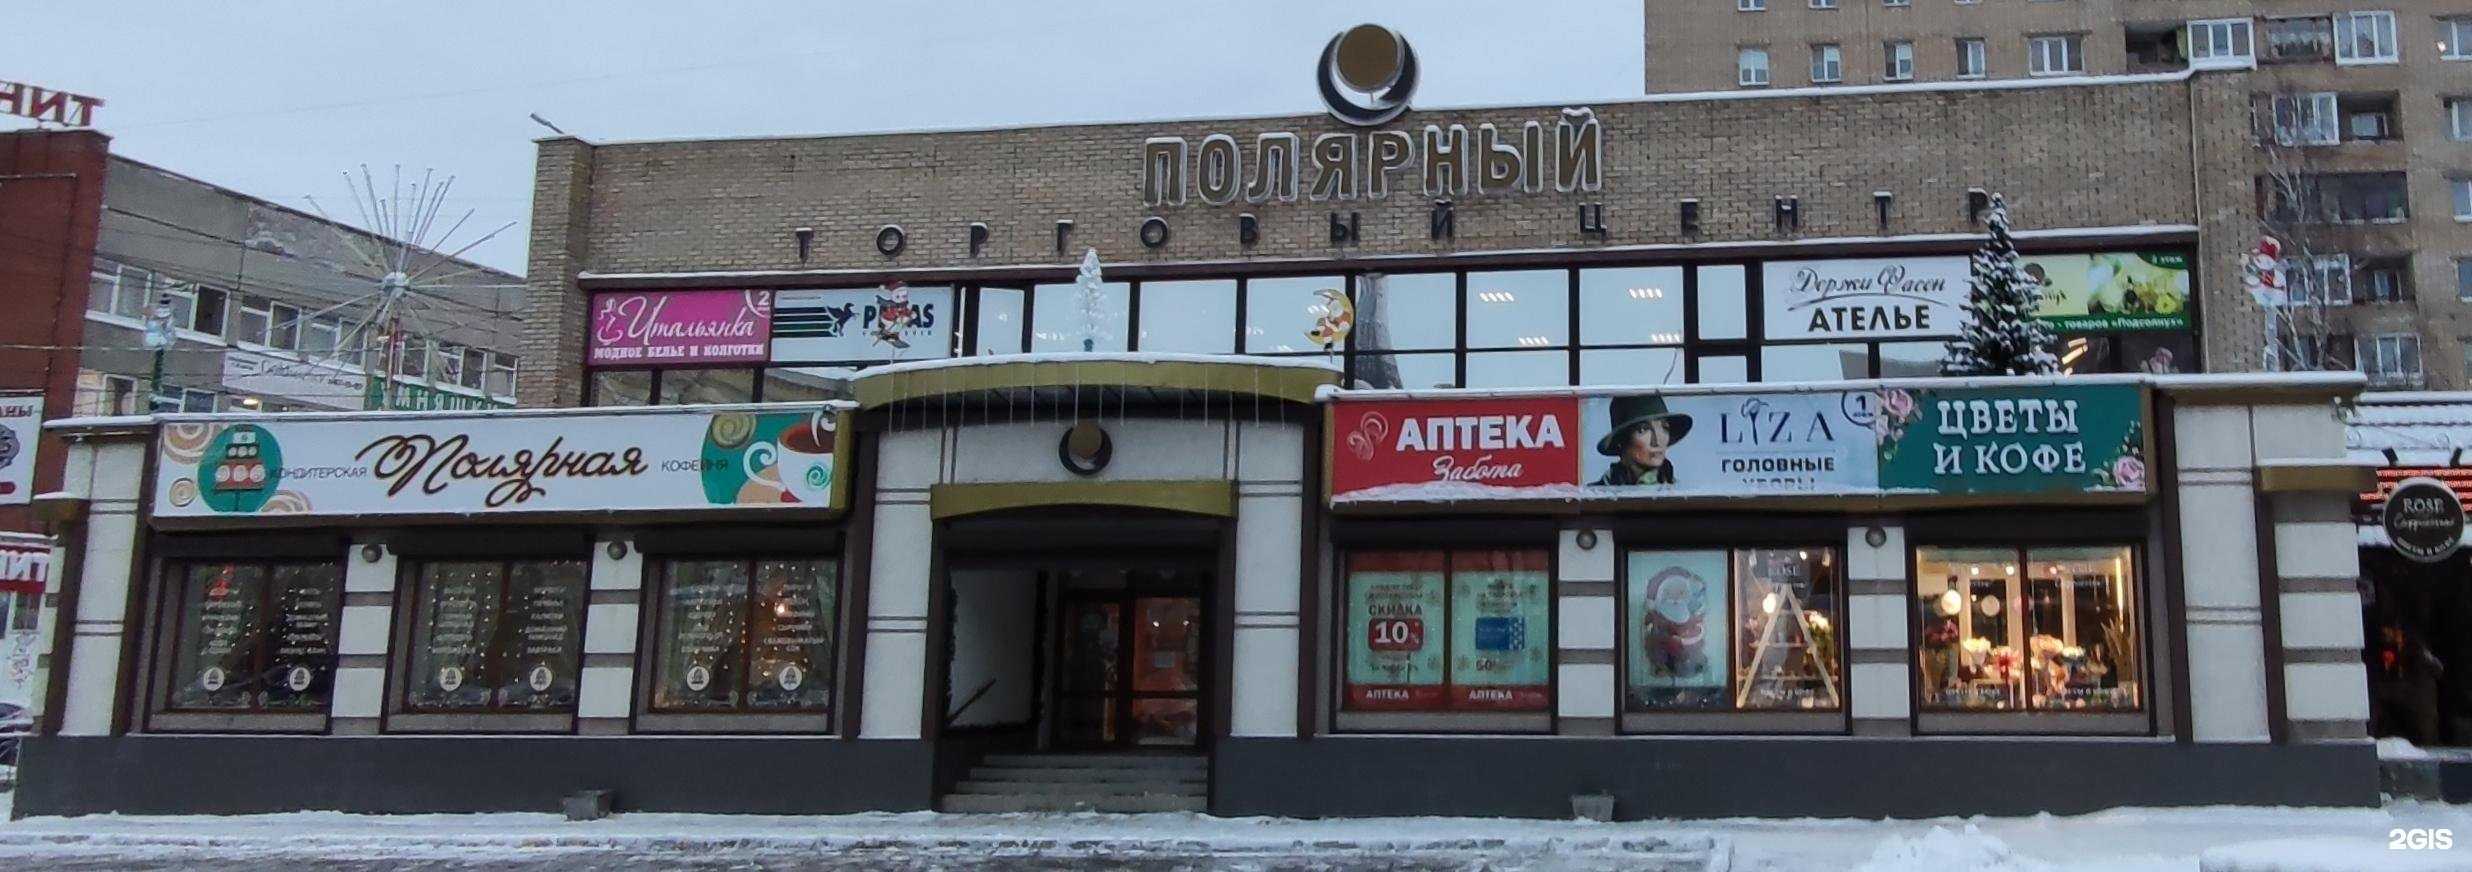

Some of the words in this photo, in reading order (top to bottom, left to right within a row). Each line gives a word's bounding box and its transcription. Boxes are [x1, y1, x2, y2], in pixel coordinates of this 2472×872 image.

[1143, 107, 1602, 206] ПОЛЯРНЫЙ
[796, 200, 1455, 264] ТОРГОВЫЙ
[1579, 187, 1989, 236] ЦЕНТР
[757, 291, 771, 305] 2
[618, 296, 754, 346] Итальянка
[863, 303, 934, 329] PAS
[1808, 304, 1930, 332] АТЕЛЬЕ
[594, 347, 643, 359] МОДНОЕ
[648, 345, 685, 357] БЕЛЬЕ
[690, 345, 699, 356] И
[704, 344, 764, 356] КОЛГОТКИ
[1856, 396, 1866, 410] 1
[1396, 414, 1565, 451] АПТЕКА
[1720, 402, 1834, 445] LIZA
[1937, 399, 2079, 440] ЦВЕТЫ
[354, 434, 648, 508] Полярная
[1433, 454, 1524, 481] Забота
[1721, 457, 1835, 472] ГОЛОВНЫЕ
[1933, 442, 1963, 474] И
[1974, 441, 2086, 474] КОФЕ
[1368, 604, 1422, 616] СКИДКА
[1366, 690, 1409, 700] АПТЕКА
[1469, 690, 1513, 700] АПТЕКА
